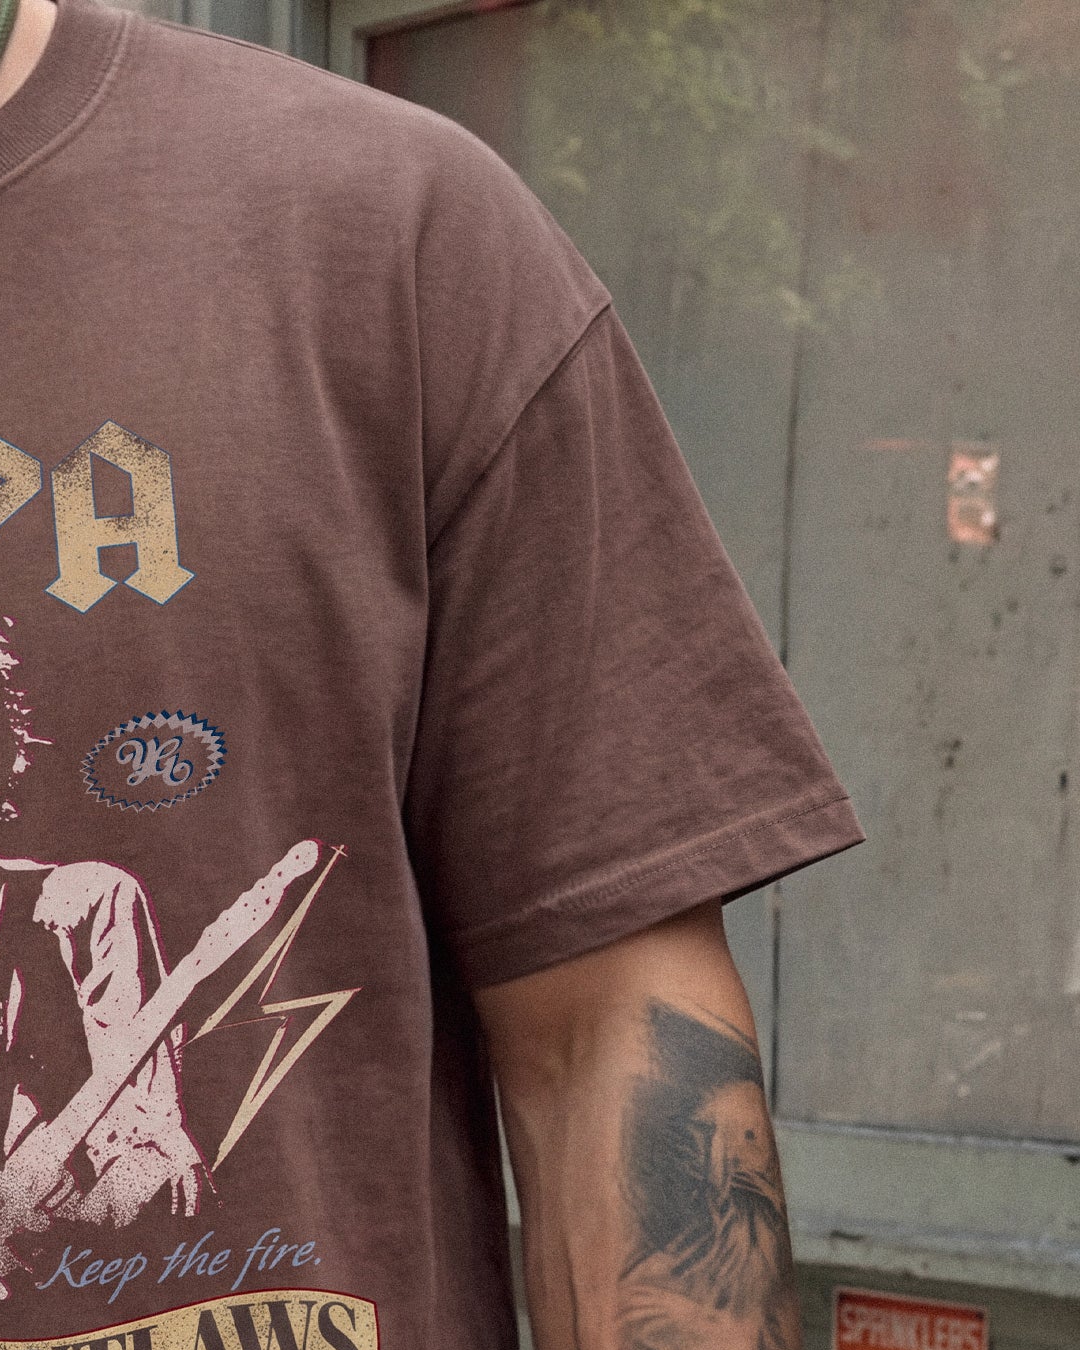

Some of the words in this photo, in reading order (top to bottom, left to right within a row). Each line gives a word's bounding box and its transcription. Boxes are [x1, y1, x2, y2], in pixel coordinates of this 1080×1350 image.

[37, 1245, 148, 1305] Keep
[157, 1231, 232, 1284] the
[230, 1227, 322, 1291] fire.
